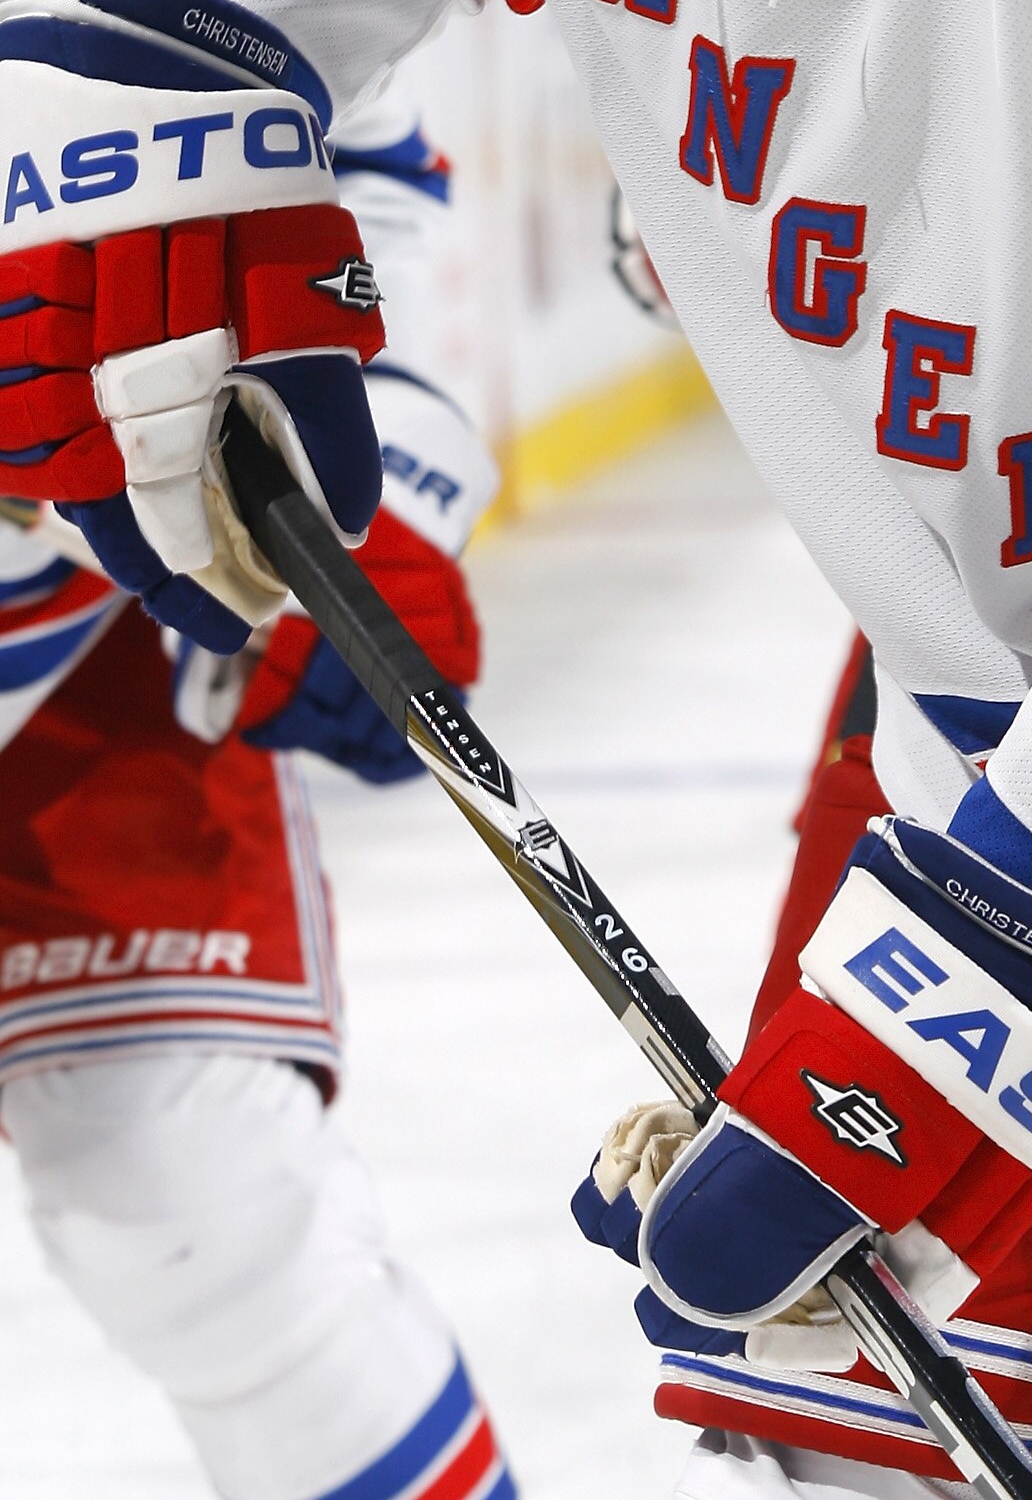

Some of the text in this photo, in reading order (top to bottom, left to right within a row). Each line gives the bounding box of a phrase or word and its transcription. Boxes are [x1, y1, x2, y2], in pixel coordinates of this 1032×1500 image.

[183, 8, 289, 76] CHRISTENSEN
[425, 690, 491, 773] TENSEN
[594, 913, 648, 973] 26
